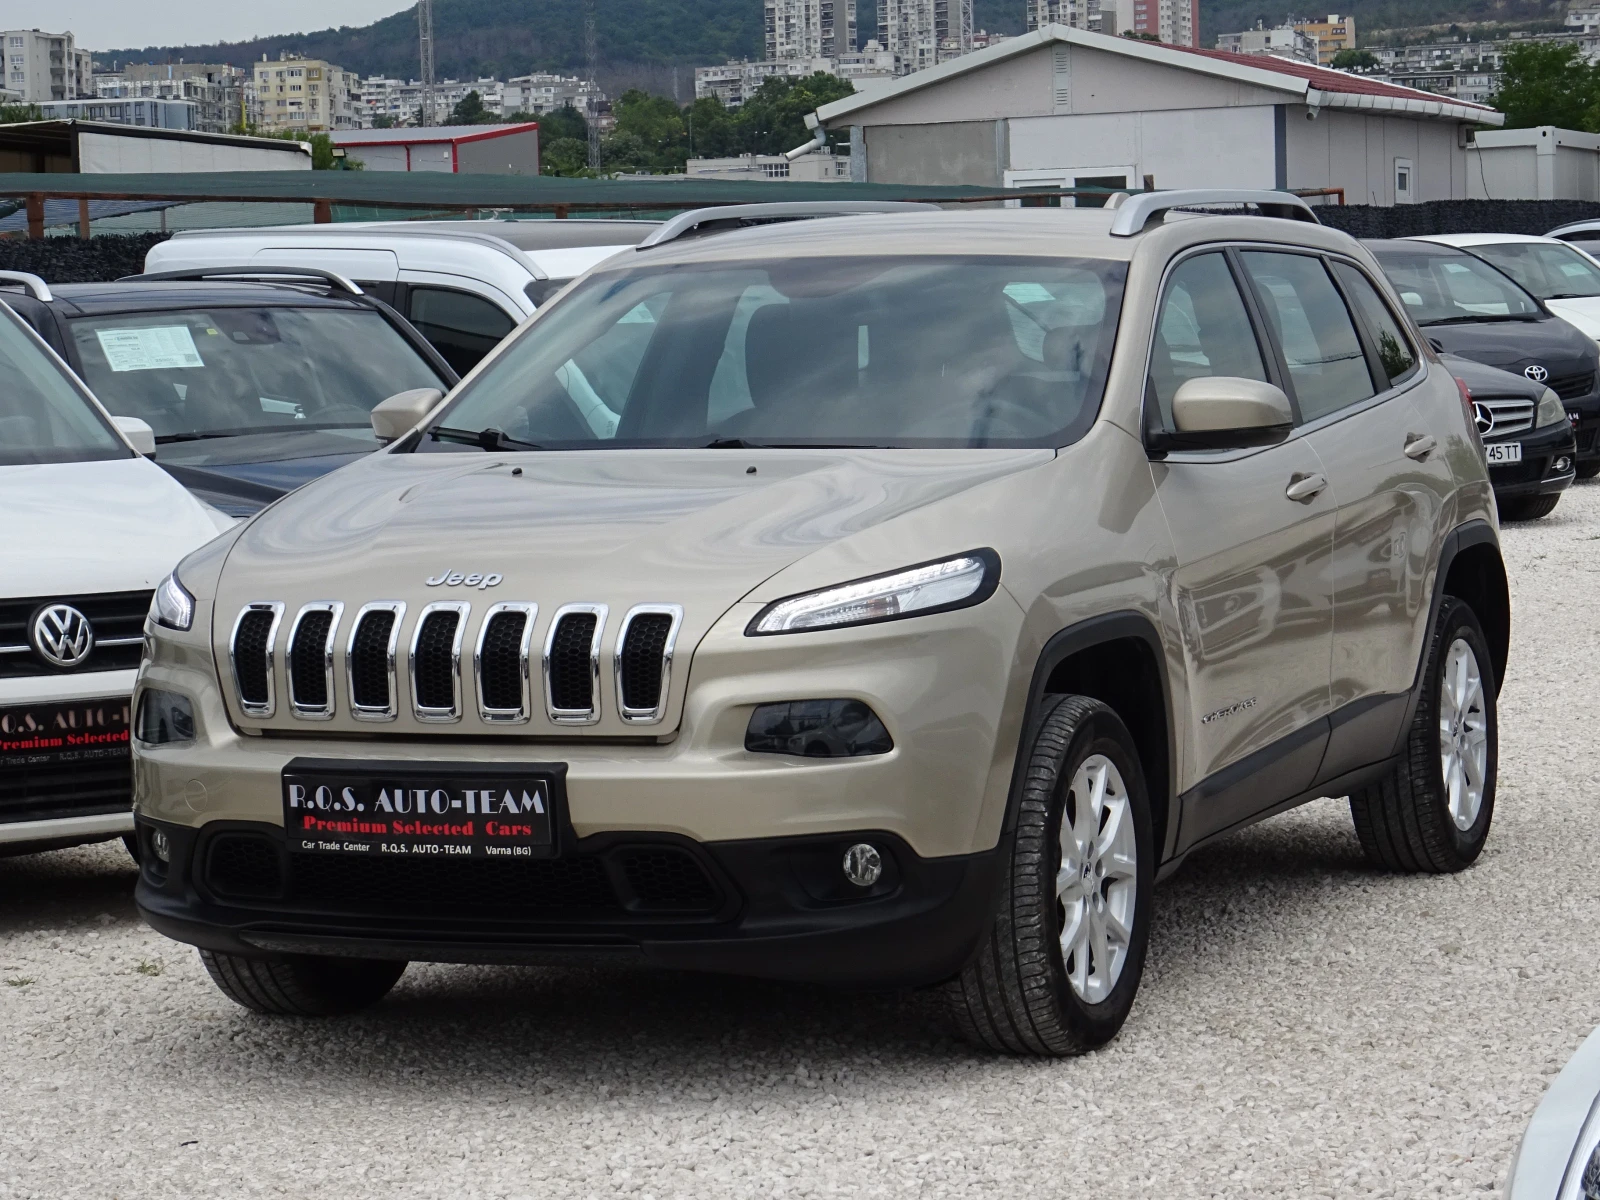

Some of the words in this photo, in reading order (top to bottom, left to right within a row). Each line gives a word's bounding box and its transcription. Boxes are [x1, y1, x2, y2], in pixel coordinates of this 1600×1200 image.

[1505, 445, 1519, 459] TT
[425, 568, 504, 591] Jeep
[66, 729, 129, 745] Selected
[289, 784, 365, 813] R.Q.S.
[374, 787, 545, 814] AUTO-TEAM
[303, 815, 387, 834] Premium
[392, 820, 474, 836] Selected
[485, 821, 532, 836] Cars
[302, 840, 315, 849] Car
[318, 841, 340, 850] Trade
[343, 842, 370, 852] Center
[381, 843, 408, 854] R.Q.S.
[412, 844, 472, 855] AUTO-TEAM
[485, 846, 511, 855] Varna
[513, 846, 532, 856] (BG)
